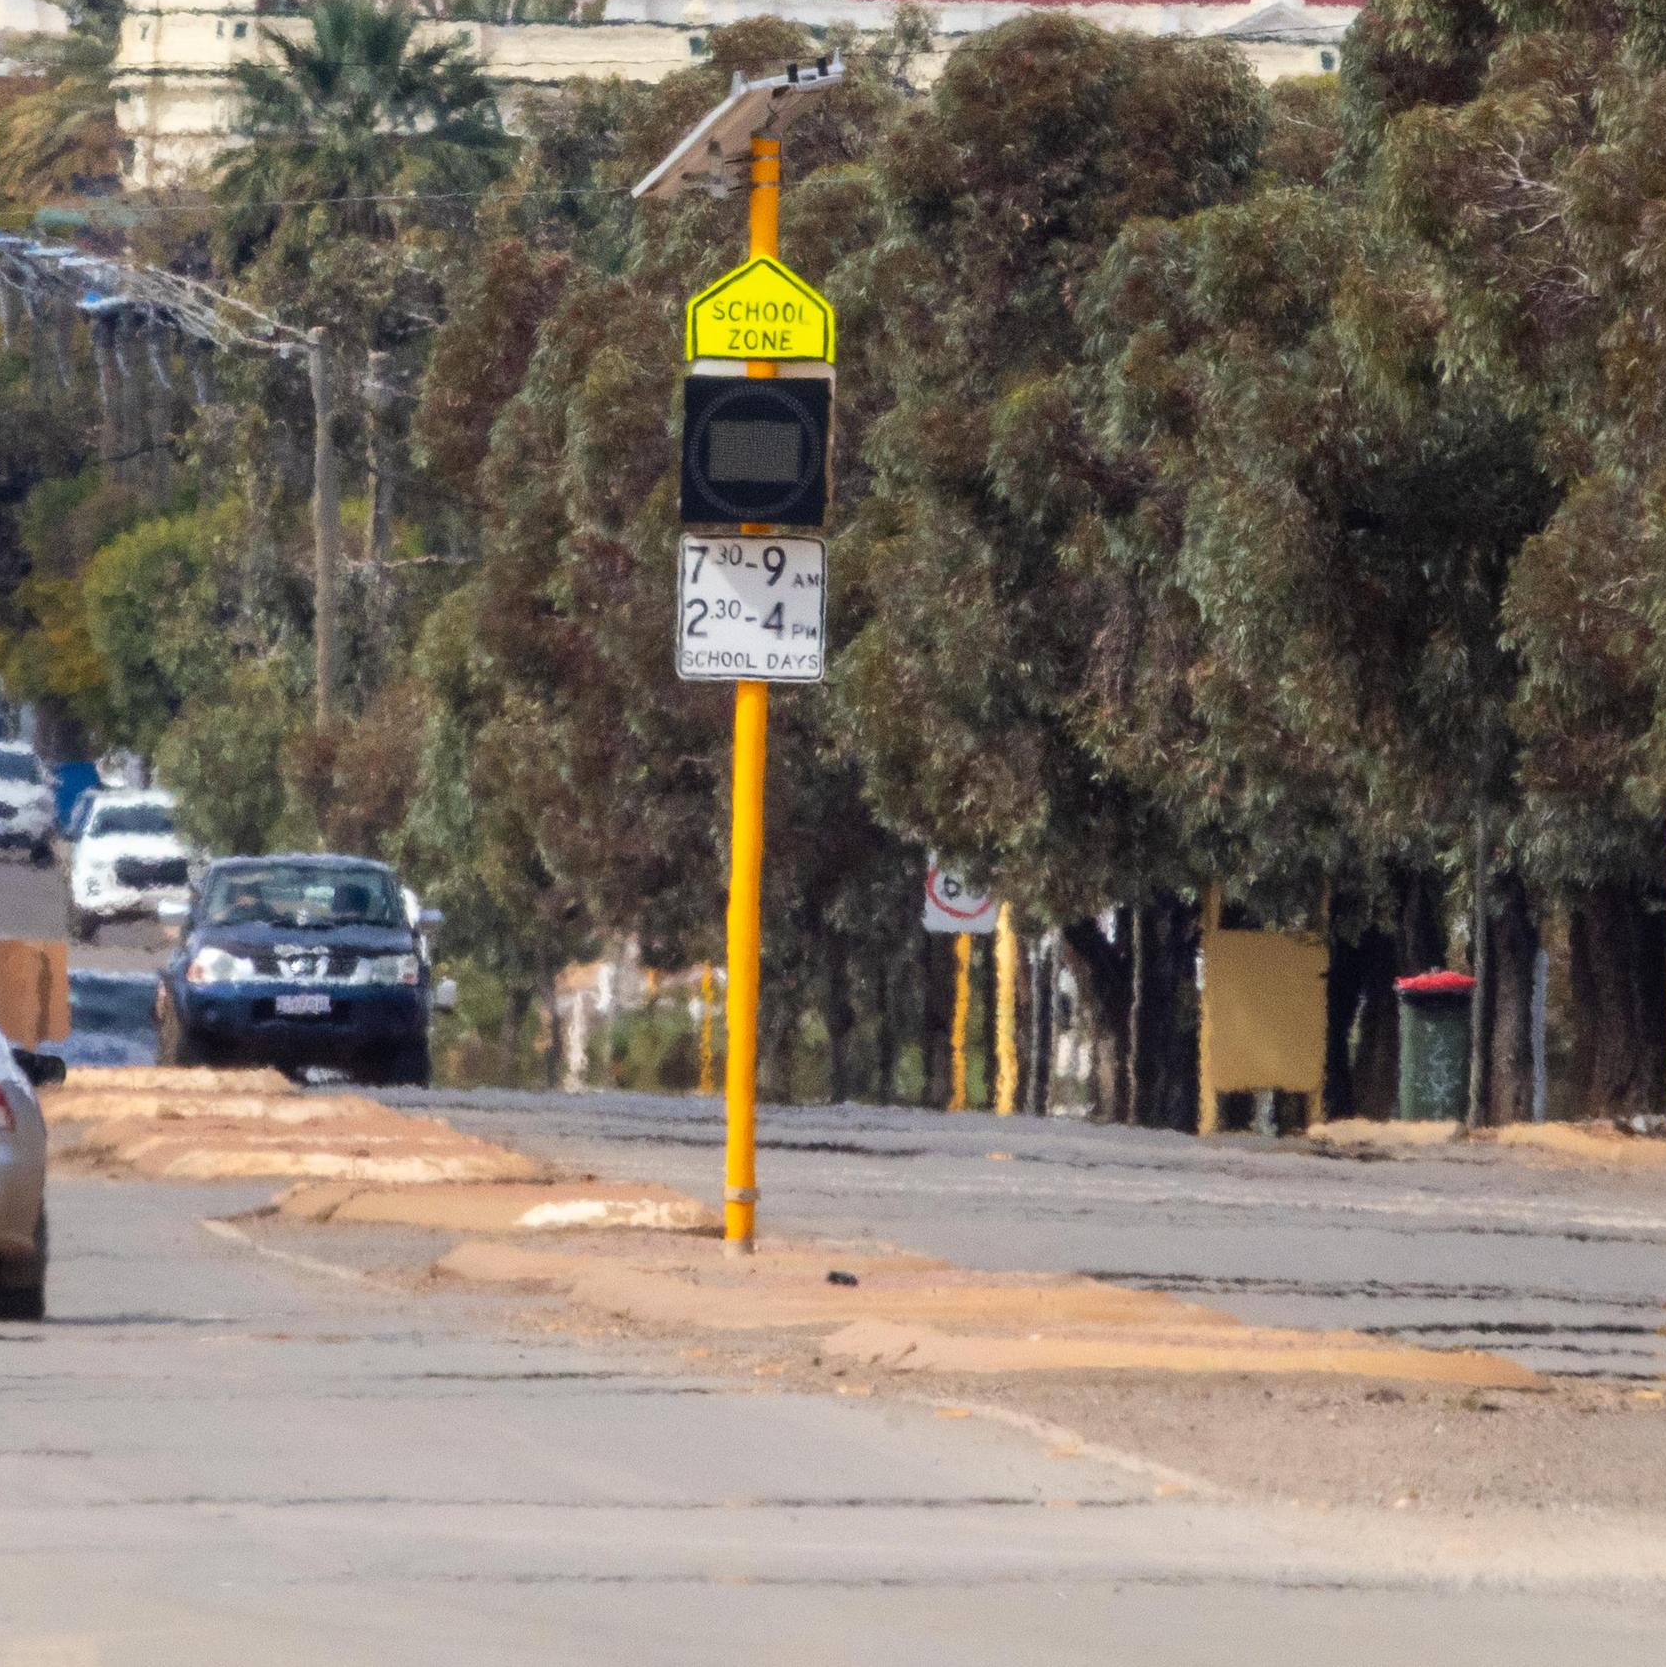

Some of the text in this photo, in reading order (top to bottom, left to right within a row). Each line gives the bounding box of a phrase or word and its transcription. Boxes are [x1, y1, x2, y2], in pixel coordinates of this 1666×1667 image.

[712, 300, 811, 325] SCHOOL
[728, 329, 794, 351] ZONE
[792, 572, 820, 588] AM
[791, 624, 818, 640] PM
[683, 650, 819, 669] SCHOOL DAYS
